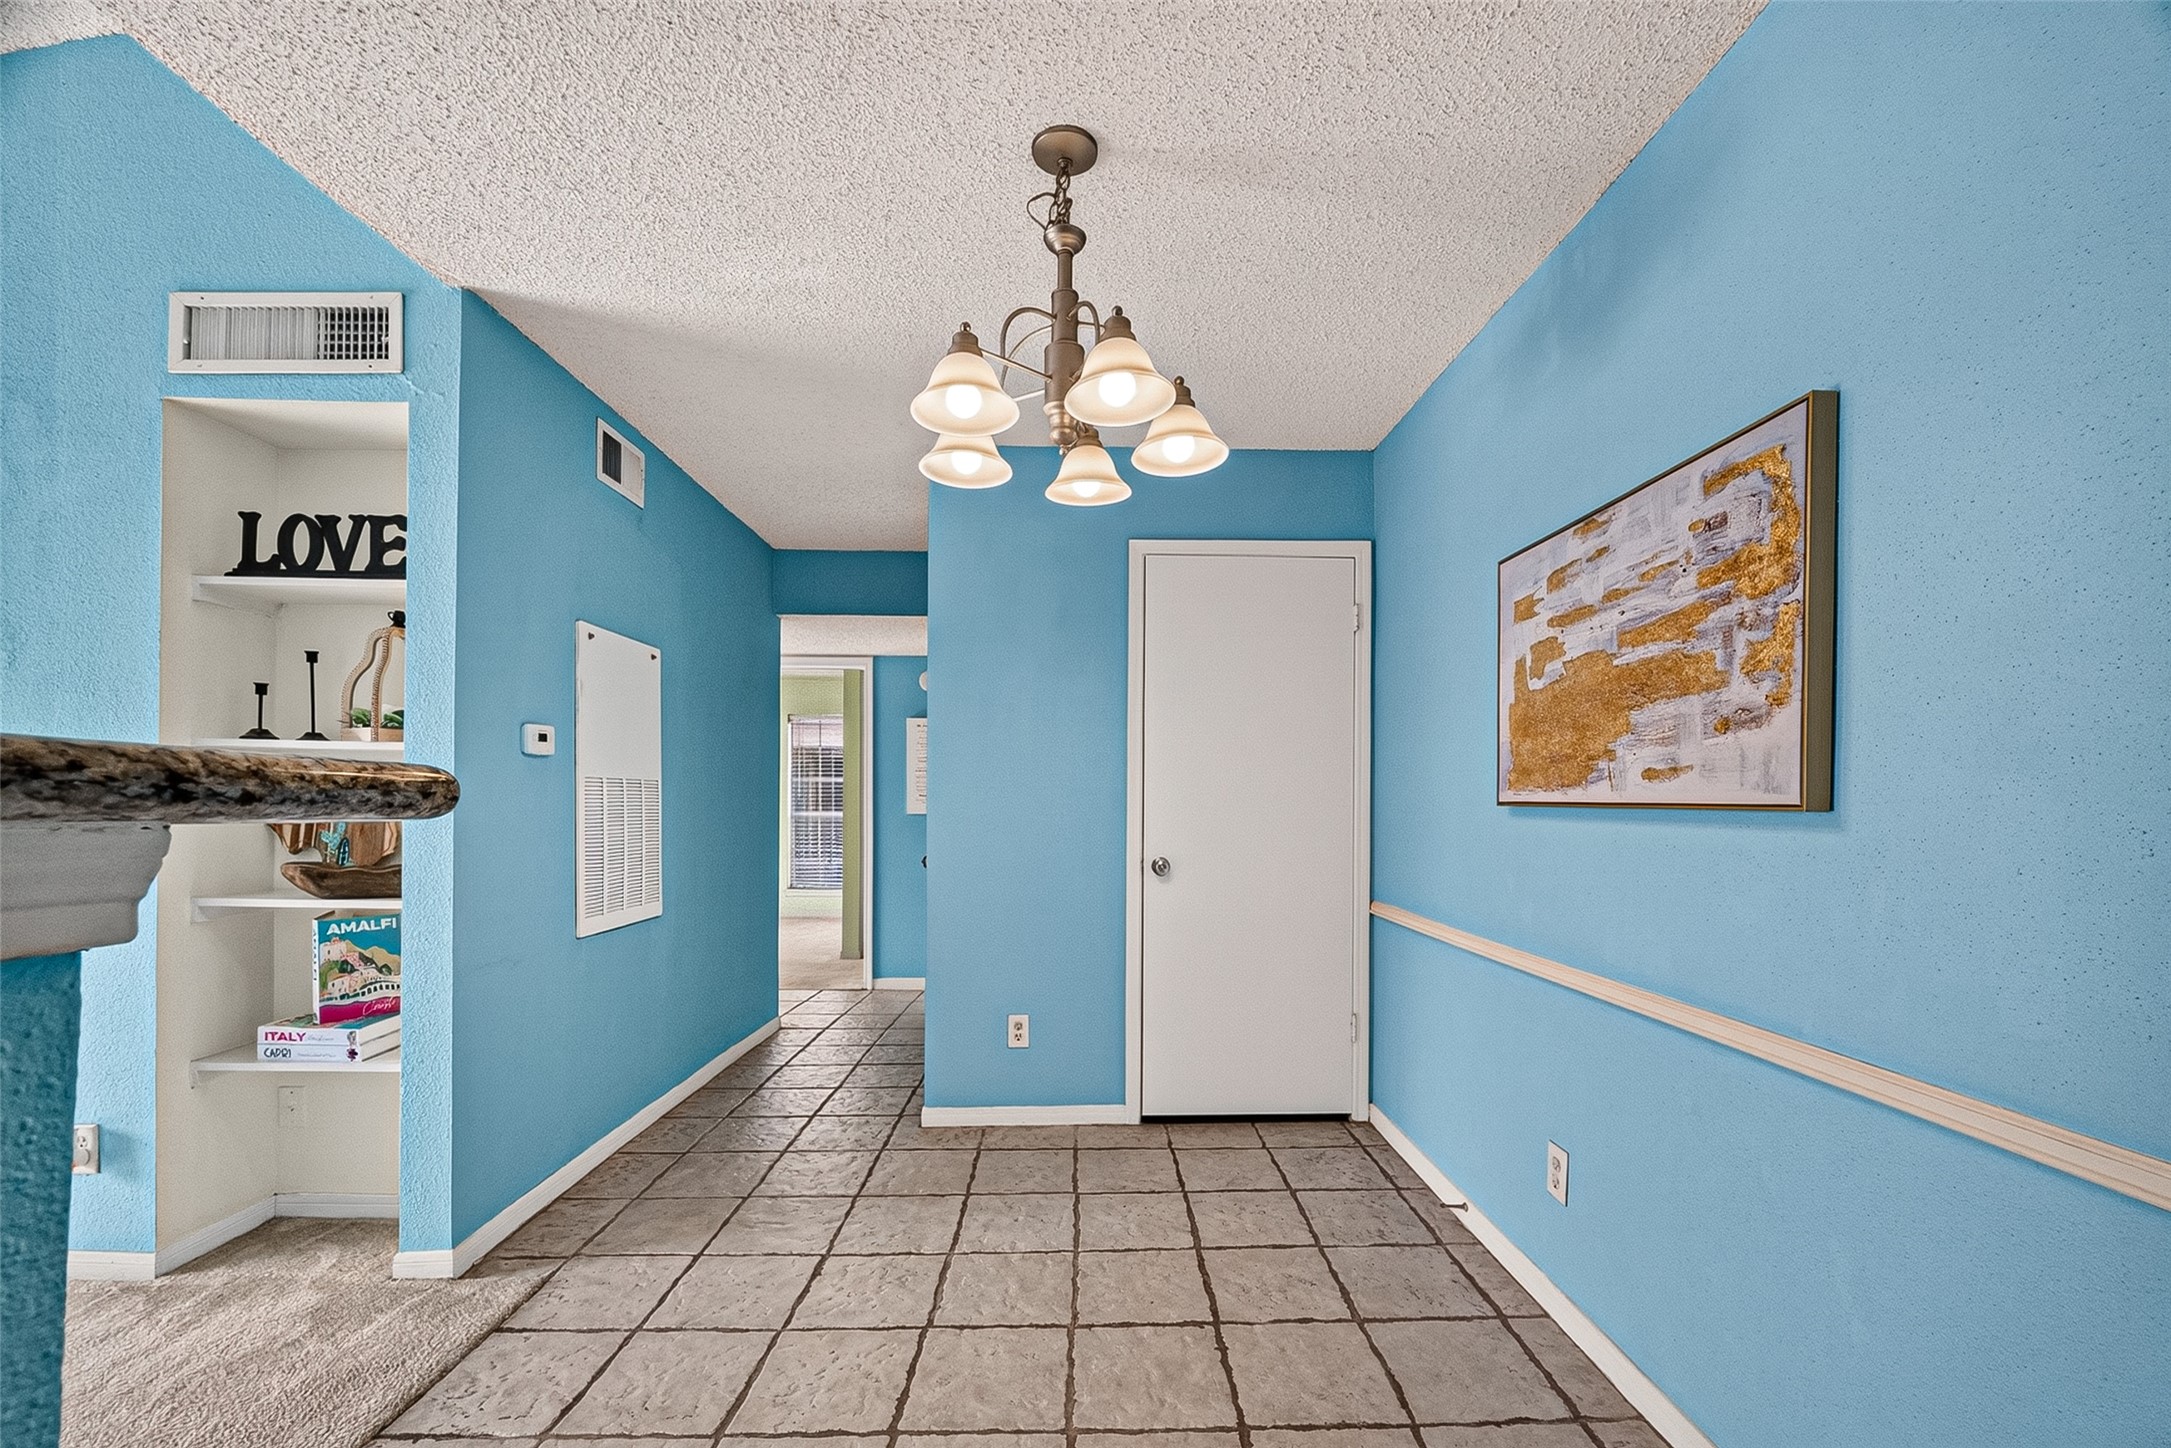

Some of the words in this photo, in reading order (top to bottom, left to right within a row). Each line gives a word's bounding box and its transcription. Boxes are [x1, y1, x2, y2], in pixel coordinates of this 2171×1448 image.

[237, 511, 407, 577] LOVE
[326, 917, 397, 936] AMALFI
[264, 1031, 306, 1042] ITALY
